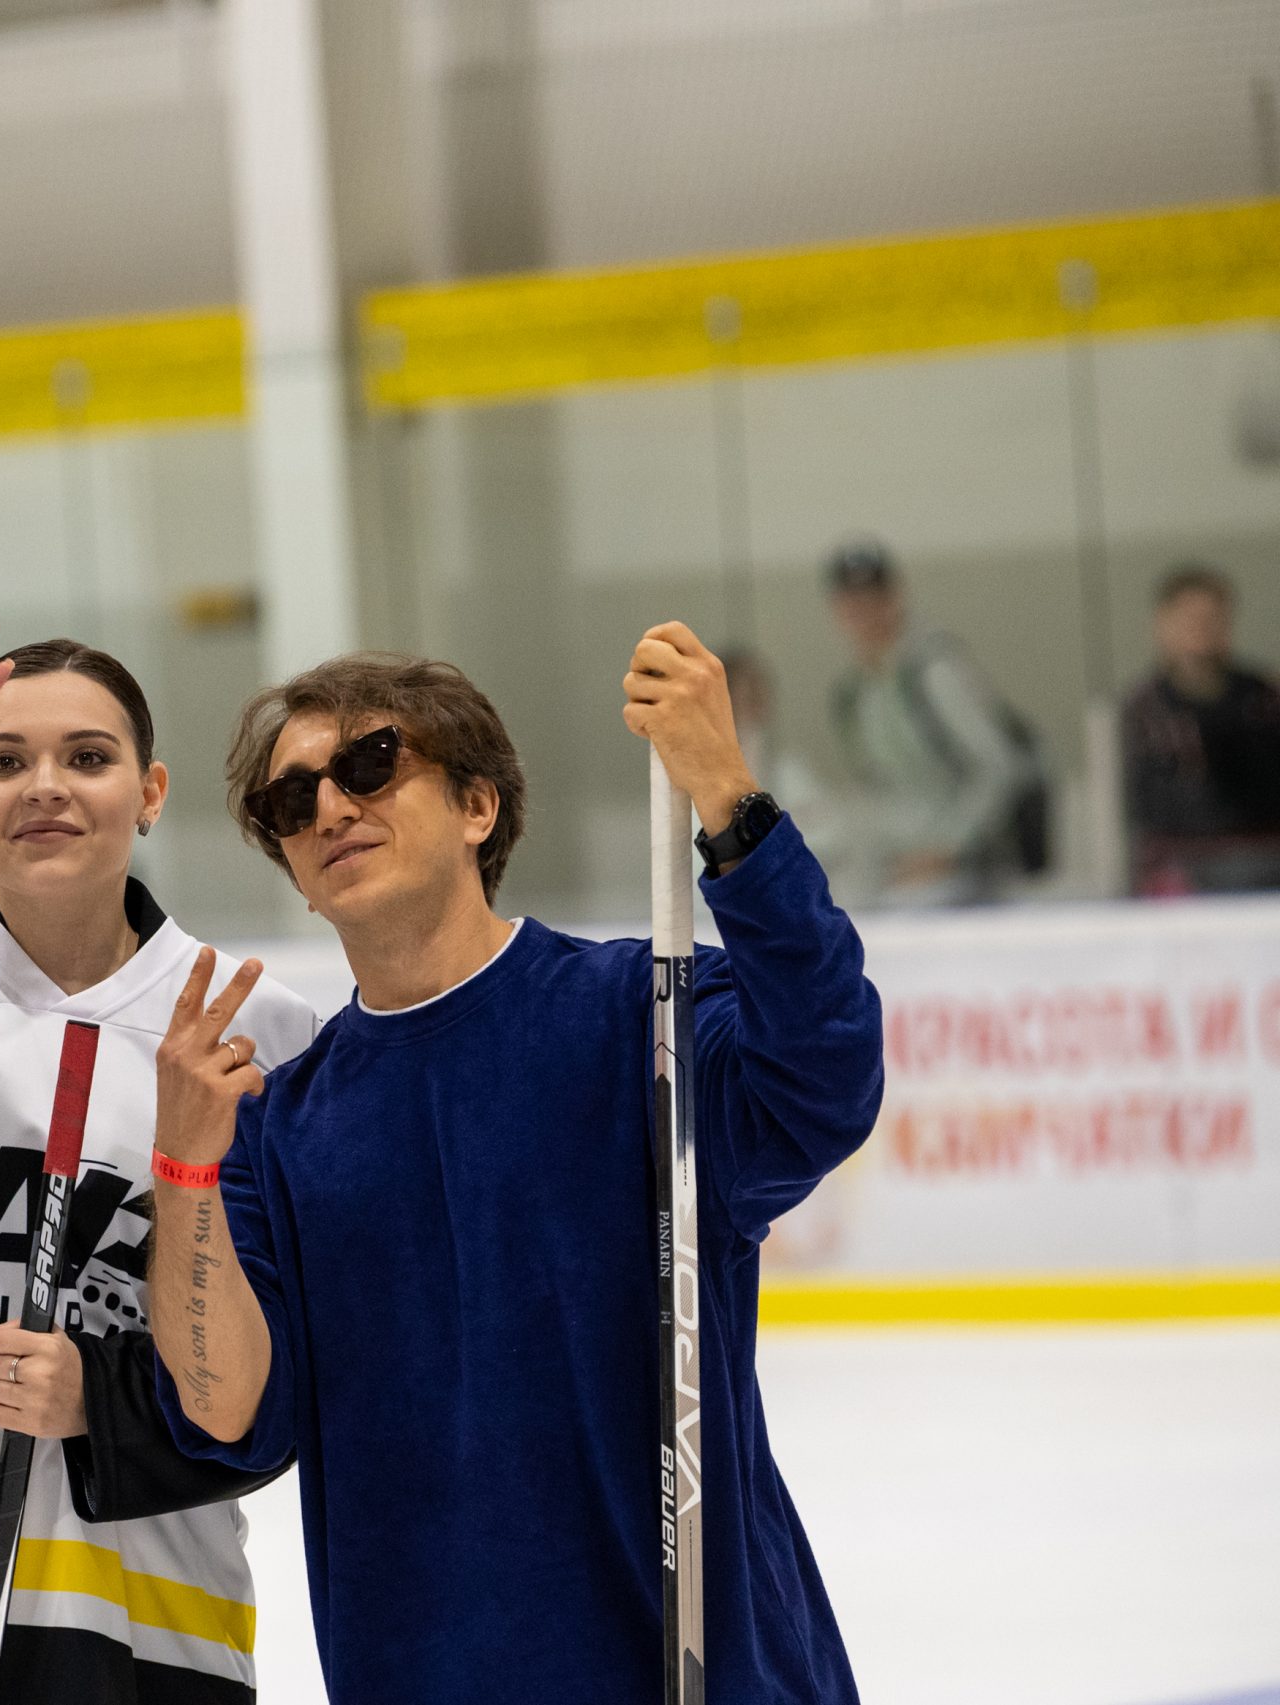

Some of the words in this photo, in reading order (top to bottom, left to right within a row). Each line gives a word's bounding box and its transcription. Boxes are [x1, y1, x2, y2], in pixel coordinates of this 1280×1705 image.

[193, 1198, 212, 1245] sun
[660, 1210, 671, 1278] PANARIN
[191, 1251, 221, 1290] my
[185, 1295, 206, 1317] is
[188, 1321, 207, 1362] son
[183, 1366, 223, 1413] My
[661, 1443, 676, 1571] BAUER
